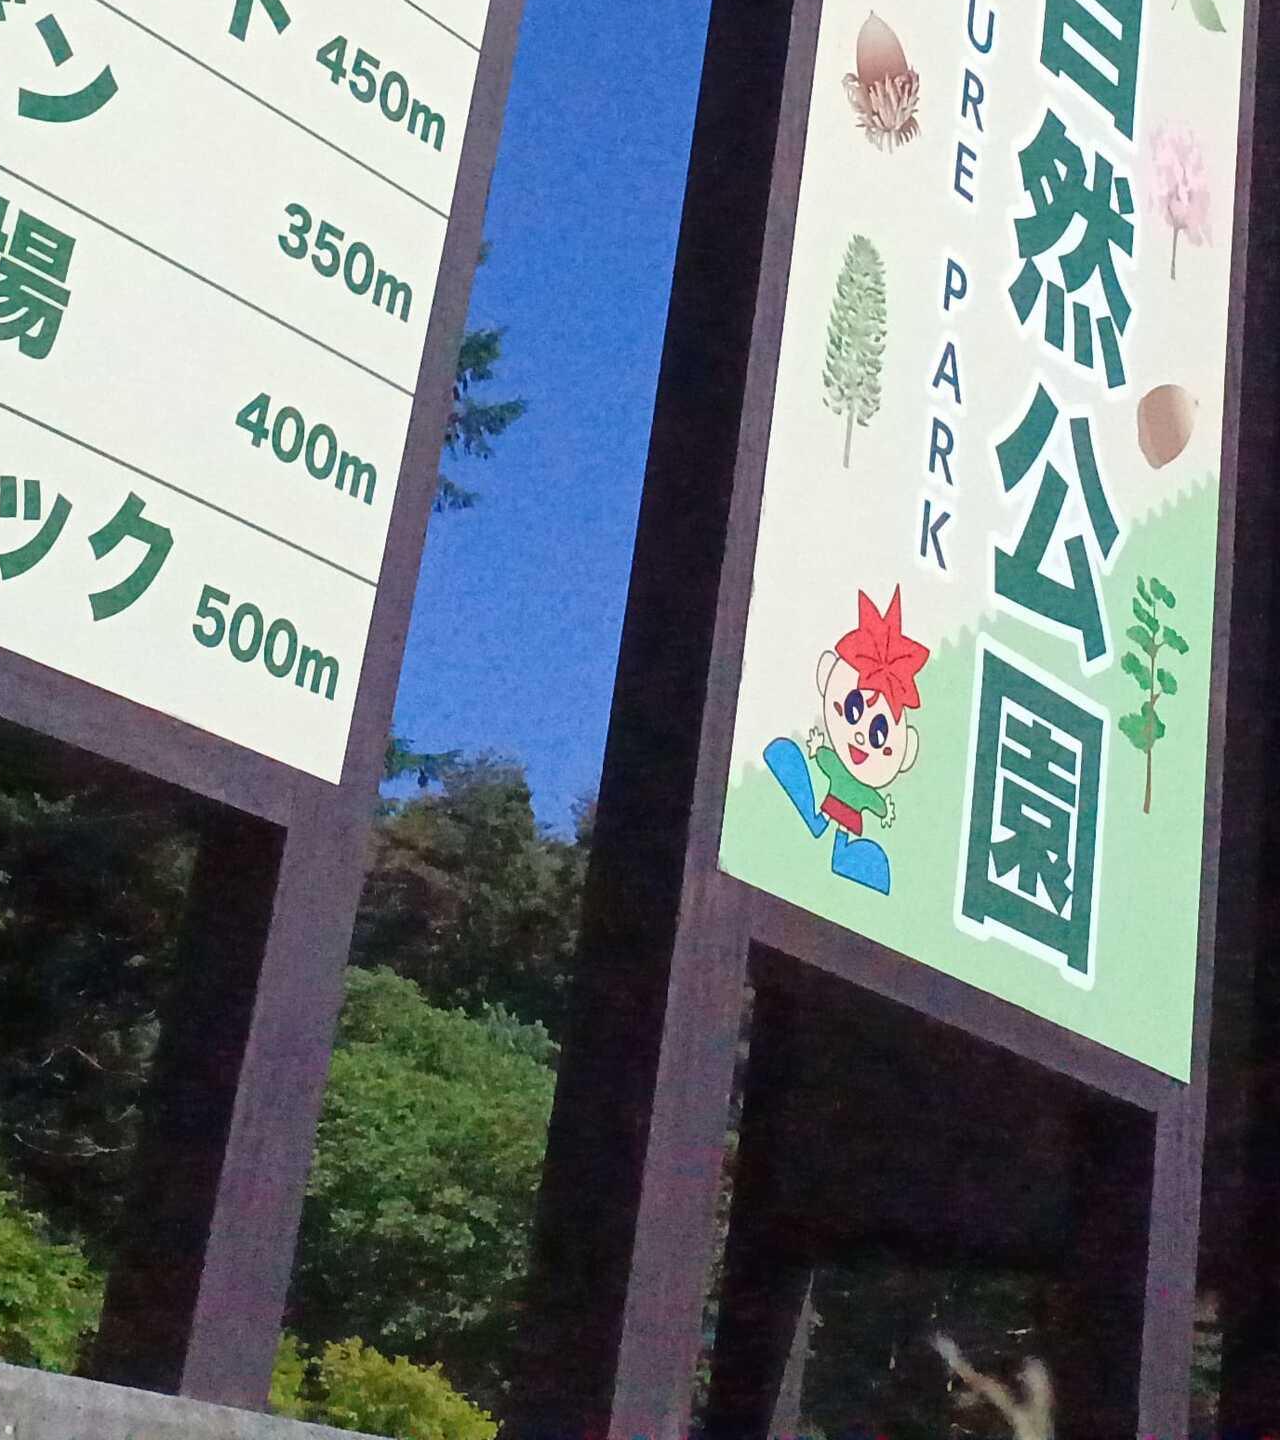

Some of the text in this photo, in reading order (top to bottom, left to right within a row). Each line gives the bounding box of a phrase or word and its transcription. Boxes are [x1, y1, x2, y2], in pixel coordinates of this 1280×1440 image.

[316, 35, 447, 153] 450m
[278, 203, 414, 324] 350m
[235, 392, 378, 506] 400m
[919, 258, 968, 571] PARK
[192, 584, 341, 701] 500m
